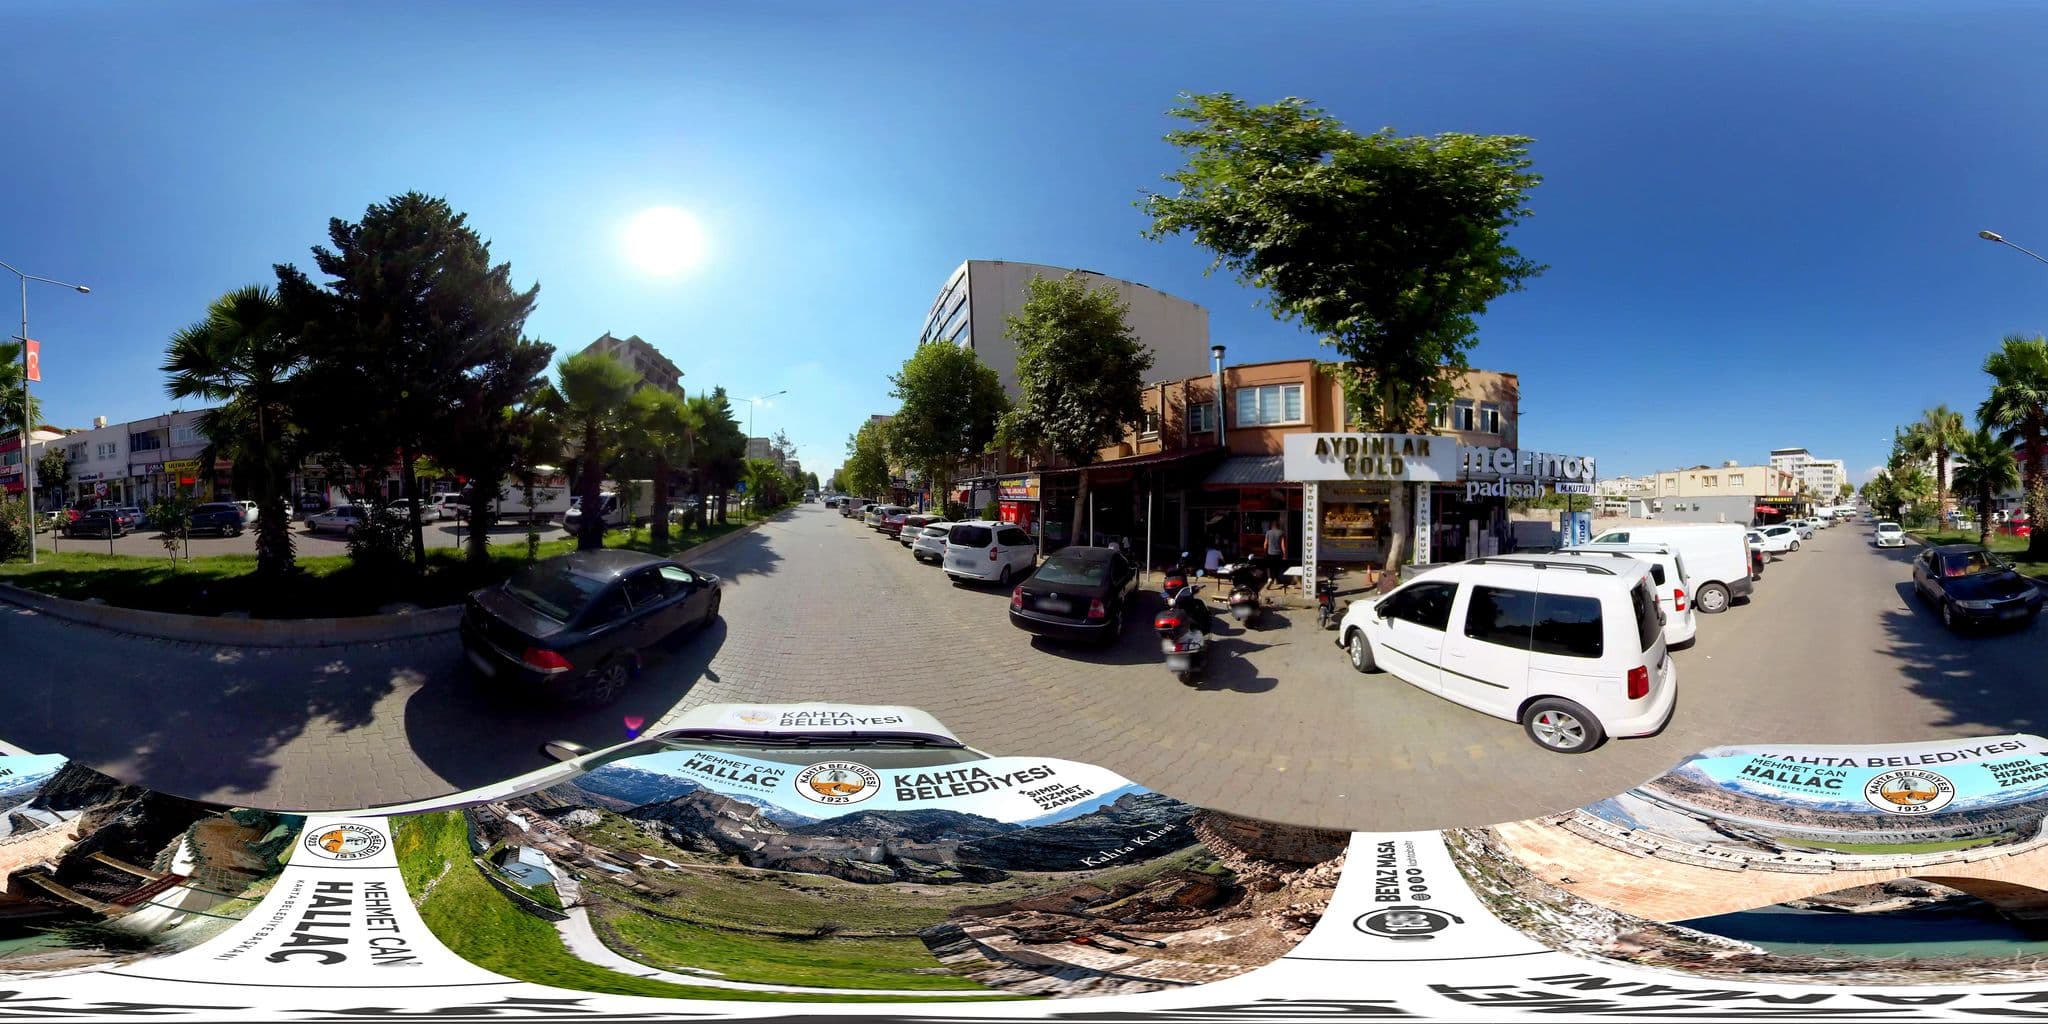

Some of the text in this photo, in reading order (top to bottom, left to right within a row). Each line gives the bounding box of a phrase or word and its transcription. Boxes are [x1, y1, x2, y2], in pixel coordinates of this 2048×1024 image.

[1315, 437, 1430, 456] AYDINLAR
[1344, 457, 1404, 475] GOLD
[1560, 484, 1591, 493] M.KUTLU
[782, 711, 851, 719] KAHTA
[694, 752, 786, 776] MEHMET CAN
[1751, 758, 1848, 777] MEHMET CAN
[894, 767, 991, 787] KAHTA
[896, 764, 1056, 801] BELEDİYESİ
[1040, 789, 1094, 810] ZAMANI
[1080, 822, 1177, 868] Kahta Kalesi
[1375, 840, 1401, 902] BEYAZ MASA
[364, 881, 401, 934] MEHMET
